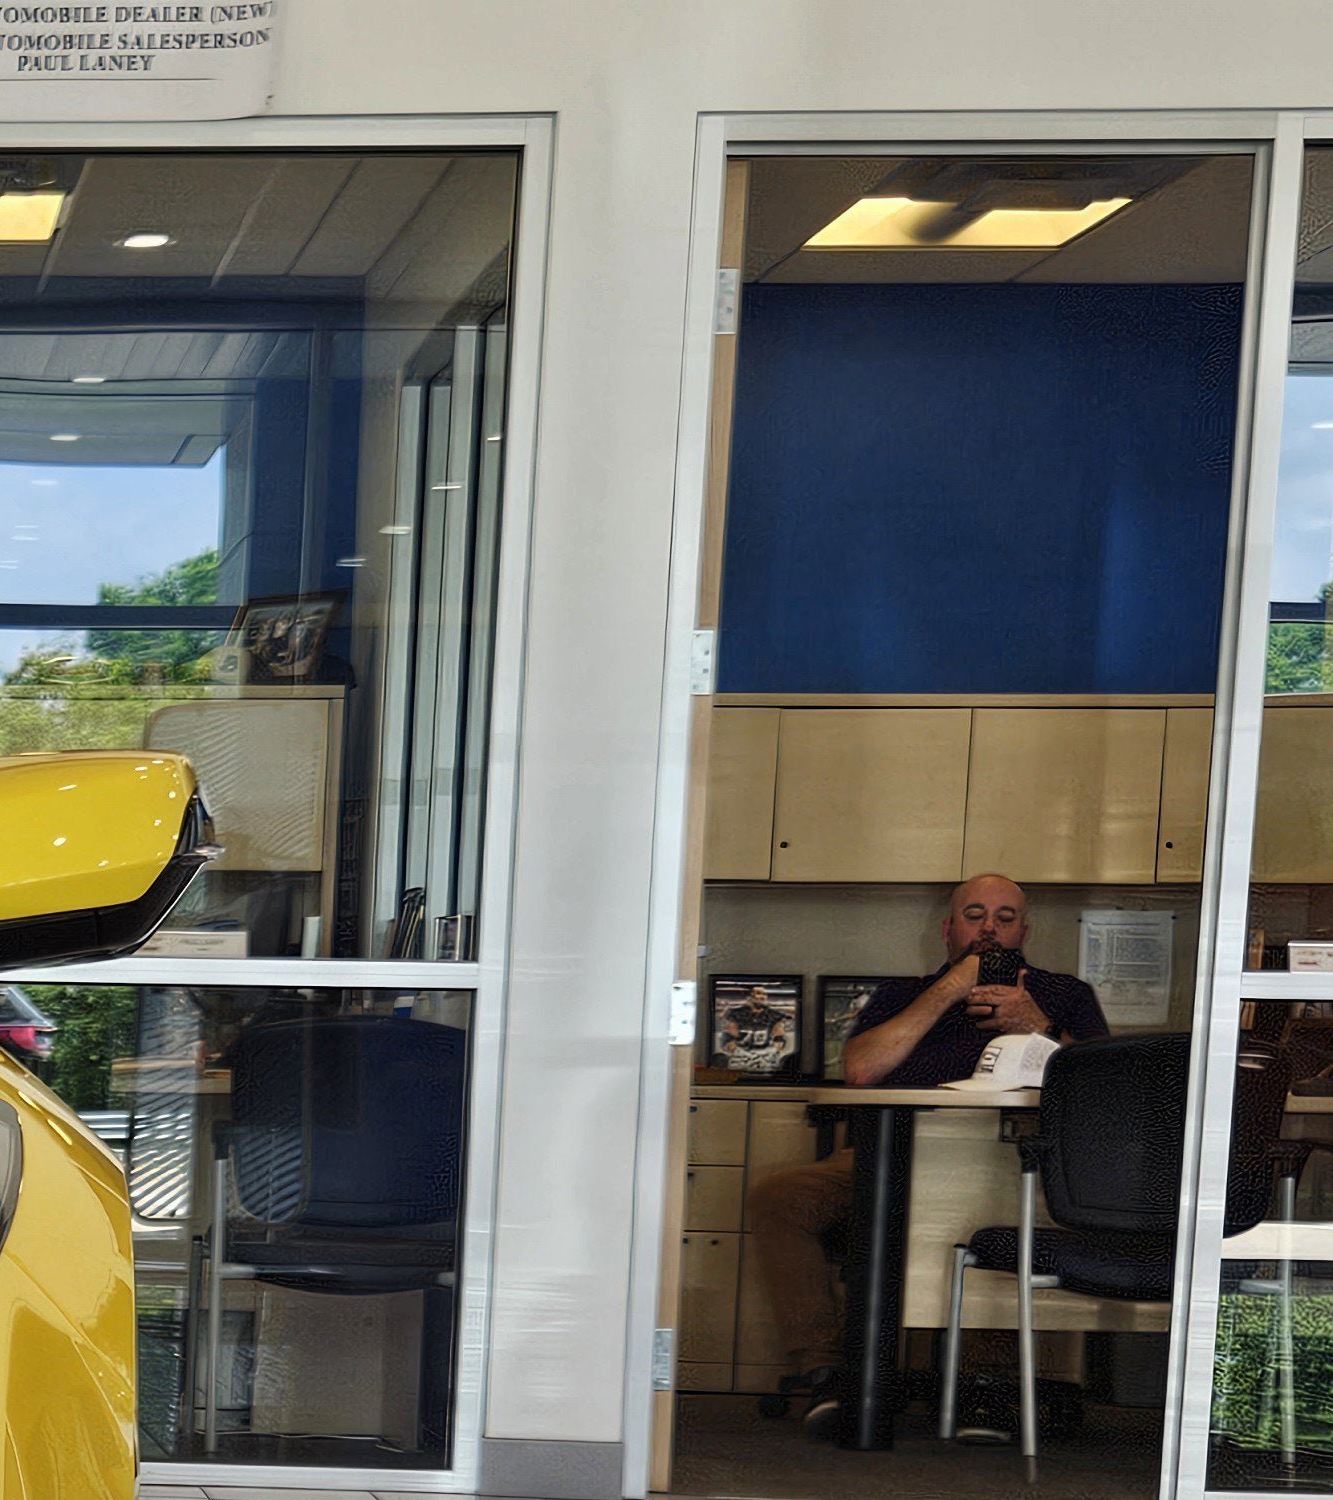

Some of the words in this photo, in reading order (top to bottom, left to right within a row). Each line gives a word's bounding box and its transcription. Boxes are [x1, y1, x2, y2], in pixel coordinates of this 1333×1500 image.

[115, 6, 205, 23] DEALER
[117, 27, 274, 51] SALESPERSON
[17, 54, 74, 72] PAUL
[79, 54, 156, 72] LANEY
